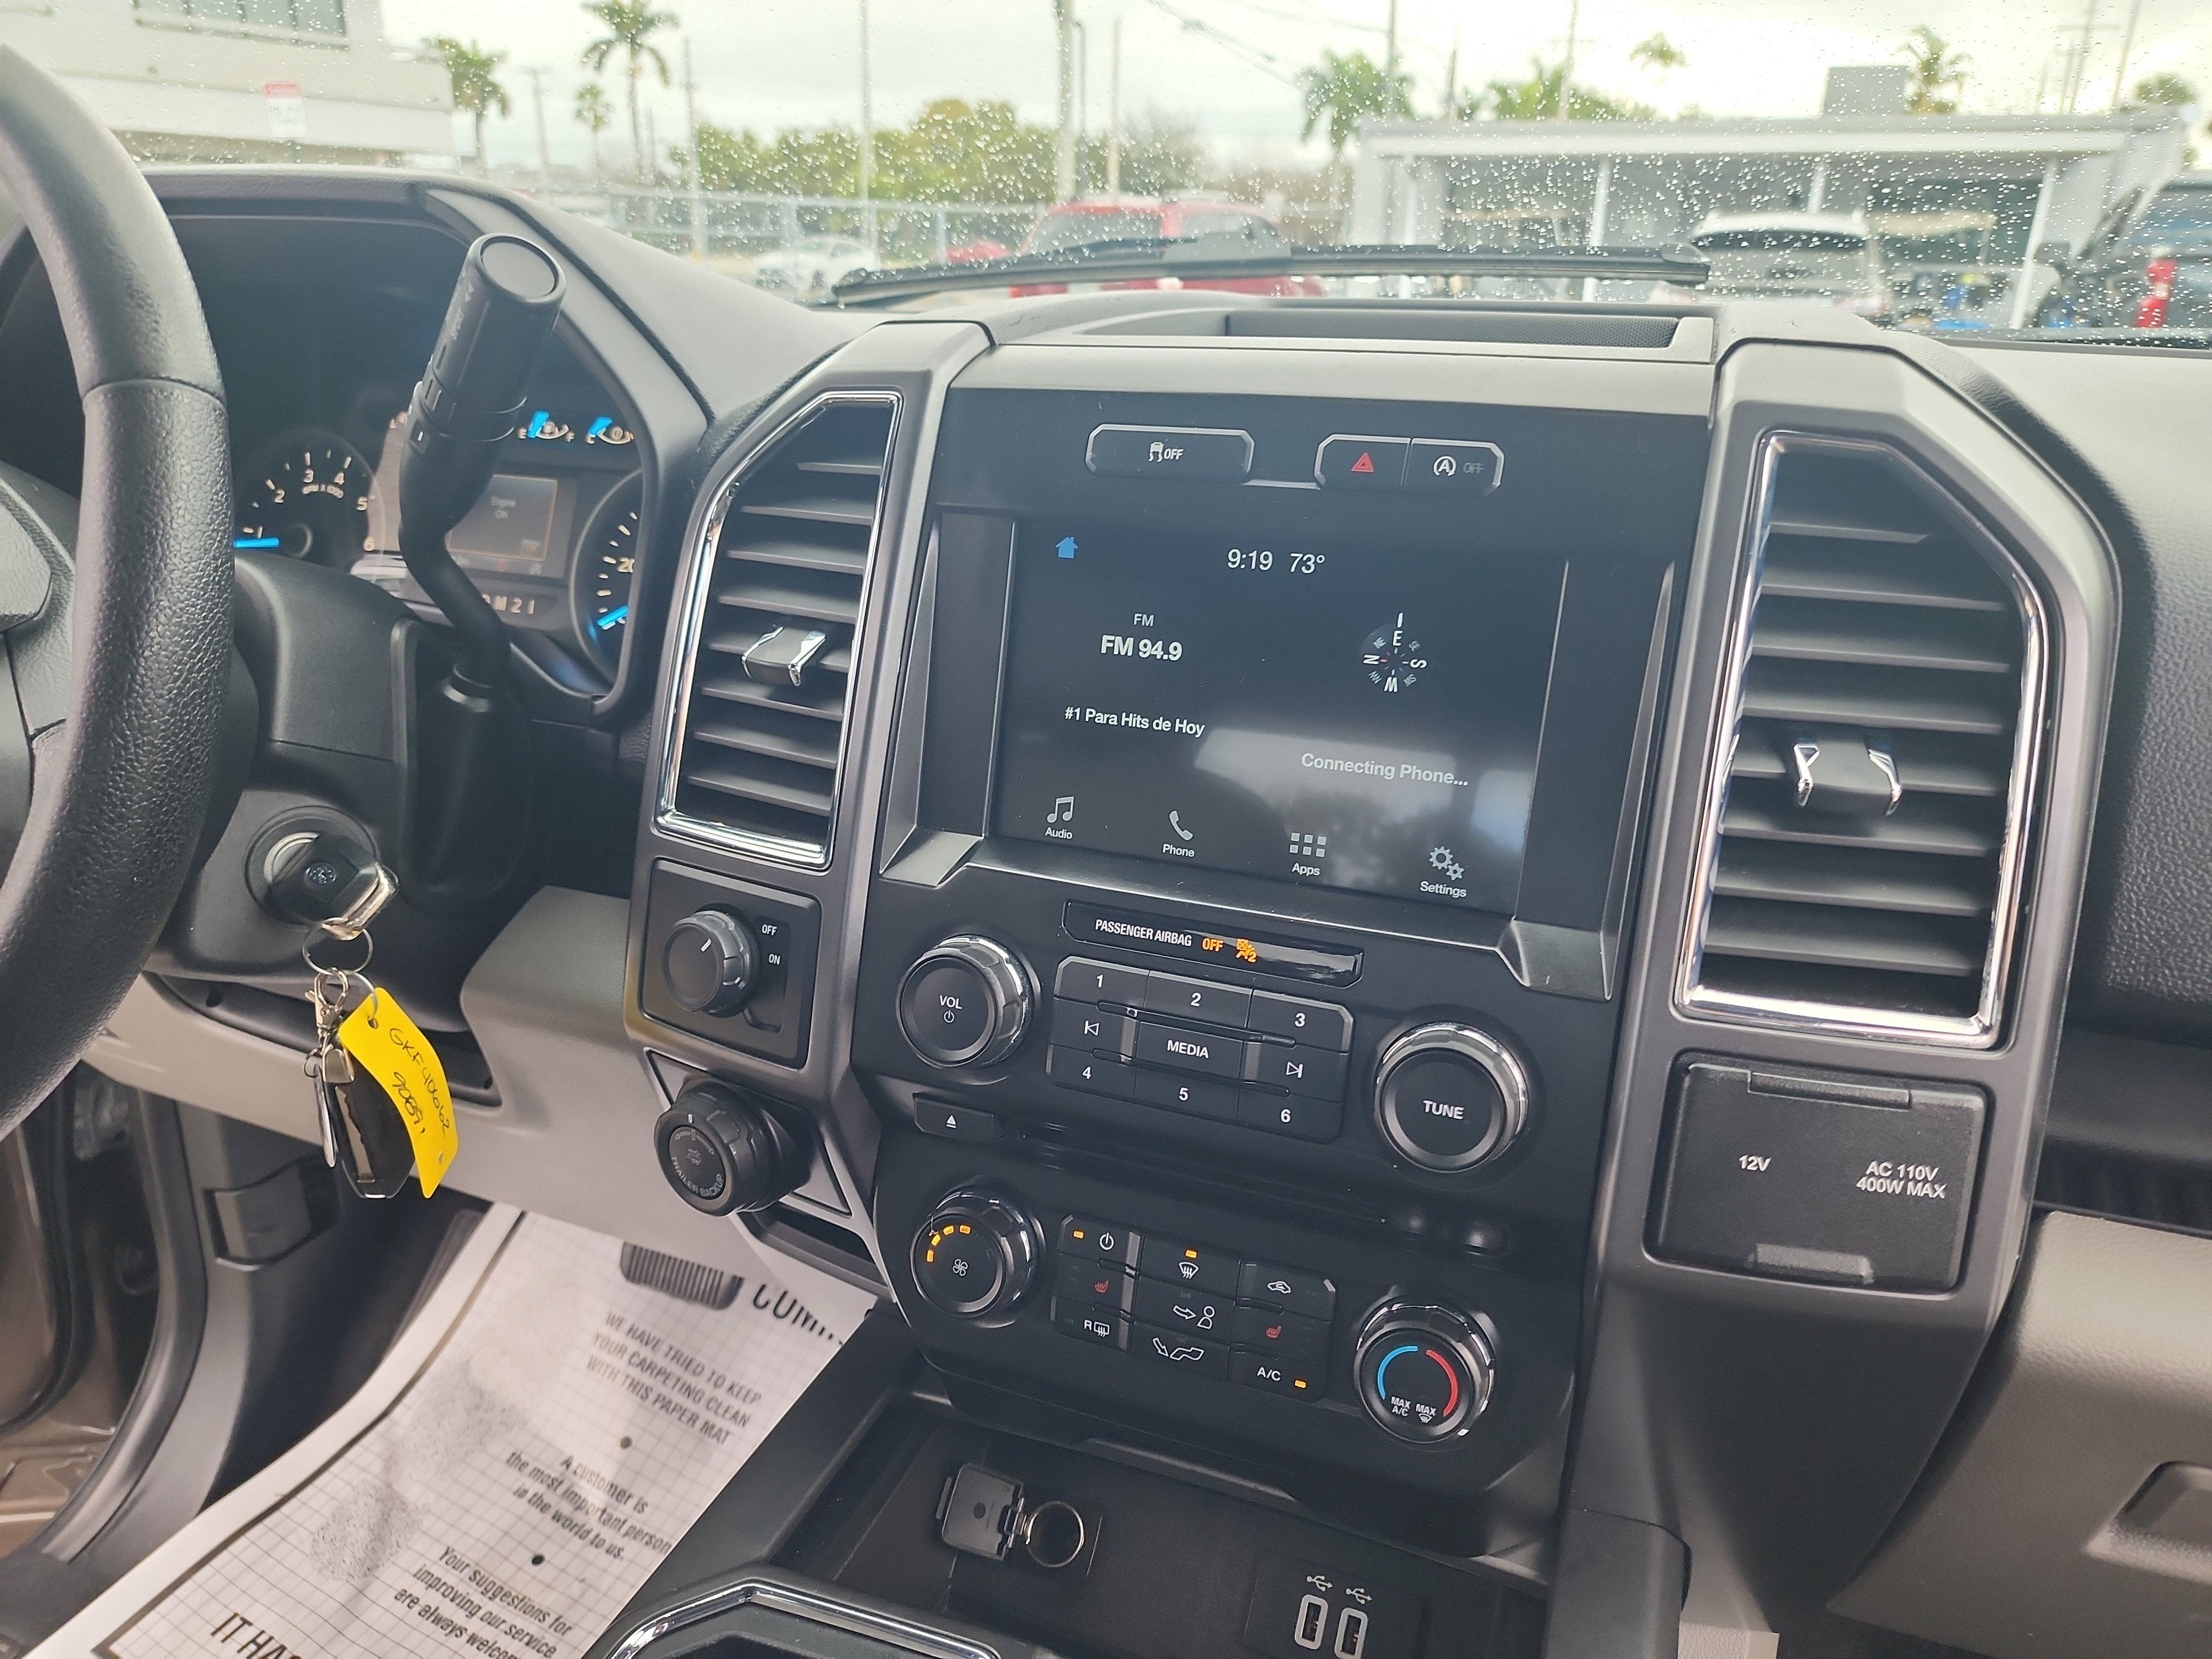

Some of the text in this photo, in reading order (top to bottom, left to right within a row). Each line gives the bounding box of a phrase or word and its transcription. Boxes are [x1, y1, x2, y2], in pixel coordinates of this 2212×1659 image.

[1164, 448, 1184, 460] OFF
[1463, 462, 1483, 473] OFF
[304, 469, 314, 483] 3
[333, 472, 345, 485] 4
[274, 489, 285, 503] 2
[356, 497, 368, 511] 5
[363, 537, 375, 551] 6
[1227, 549, 1326, 573] 9:19 73°
[1134, 613, 1155, 627] FM
[1392, 630, 1403, 646] E
[1100, 634, 1183, 661] FM 94.9
[1363, 654, 1380, 665] N
[1410, 659, 1427, 669] S
[1384, 676, 1398, 693] W
[1064, 706, 1206, 738] #1 Para Hits de Hoy
[1301, 753, 1469, 786] Connecting Phone...
[1045, 827, 1073, 839] Audio
[1162, 843, 1195, 857] Phone
[1291, 863, 1321, 877] Apps
[1420, 880, 1467, 898] Settings
[761, 924, 778, 936] OFF
[1094, 919, 1153, 940] PASSENGER
[1154, 930, 1192, 947] AIRBAG
[1202, 938, 1224, 952] OFF
[769, 953, 781, 965] ON
[1097, 974, 1103, 988] 1
[940, 995, 963, 1009] VOL
[1190, 993, 1201, 1006] 2
[1295, 1013, 1306, 1027] 3
[1167, 1040, 1209, 1058] MEDIA
[1082, 1066, 1092, 1079] 4
[1179, 1087, 1188, 1101] 5
[1281, 1109, 1291, 1123] 6
[1423, 1100, 1465, 1119] TUNE
[1739, 1155, 1771, 1171] 12V
[1865, 1161, 1939, 1182] AC 110V
[1856, 1176, 1947, 1199] 400W MAX
[1084, 1319, 1092, 1331] R
[606, 1311, 762, 1406] WE HAVE TRIED TO KEEP
[593, 1332, 750, 1427] YOUR CARPETING CLEAN
[1256, 1366, 1281, 1381] A/C
[587, 1355, 731, 1444] WITH THIS PAPER MAT
[1391, 1396, 1411, 1409] MAX
[1391, 1405, 1408, 1416] A/C
[1416, 1404, 1437, 1416] MAX
[560, 1454, 648, 1514] A customer is
[506, 1451, 672, 1553] the most important person
[513, 1485, 624, 1561] in the world to us.
[438, 1547, 573, 1636] Your suggestions for
[394, 1589, 420, 1609] are
[419, 1604, 467, 1639] always
[413, 1563, 557, 1658] improving our service
[210, 1612, 302, 1659] IT HA
